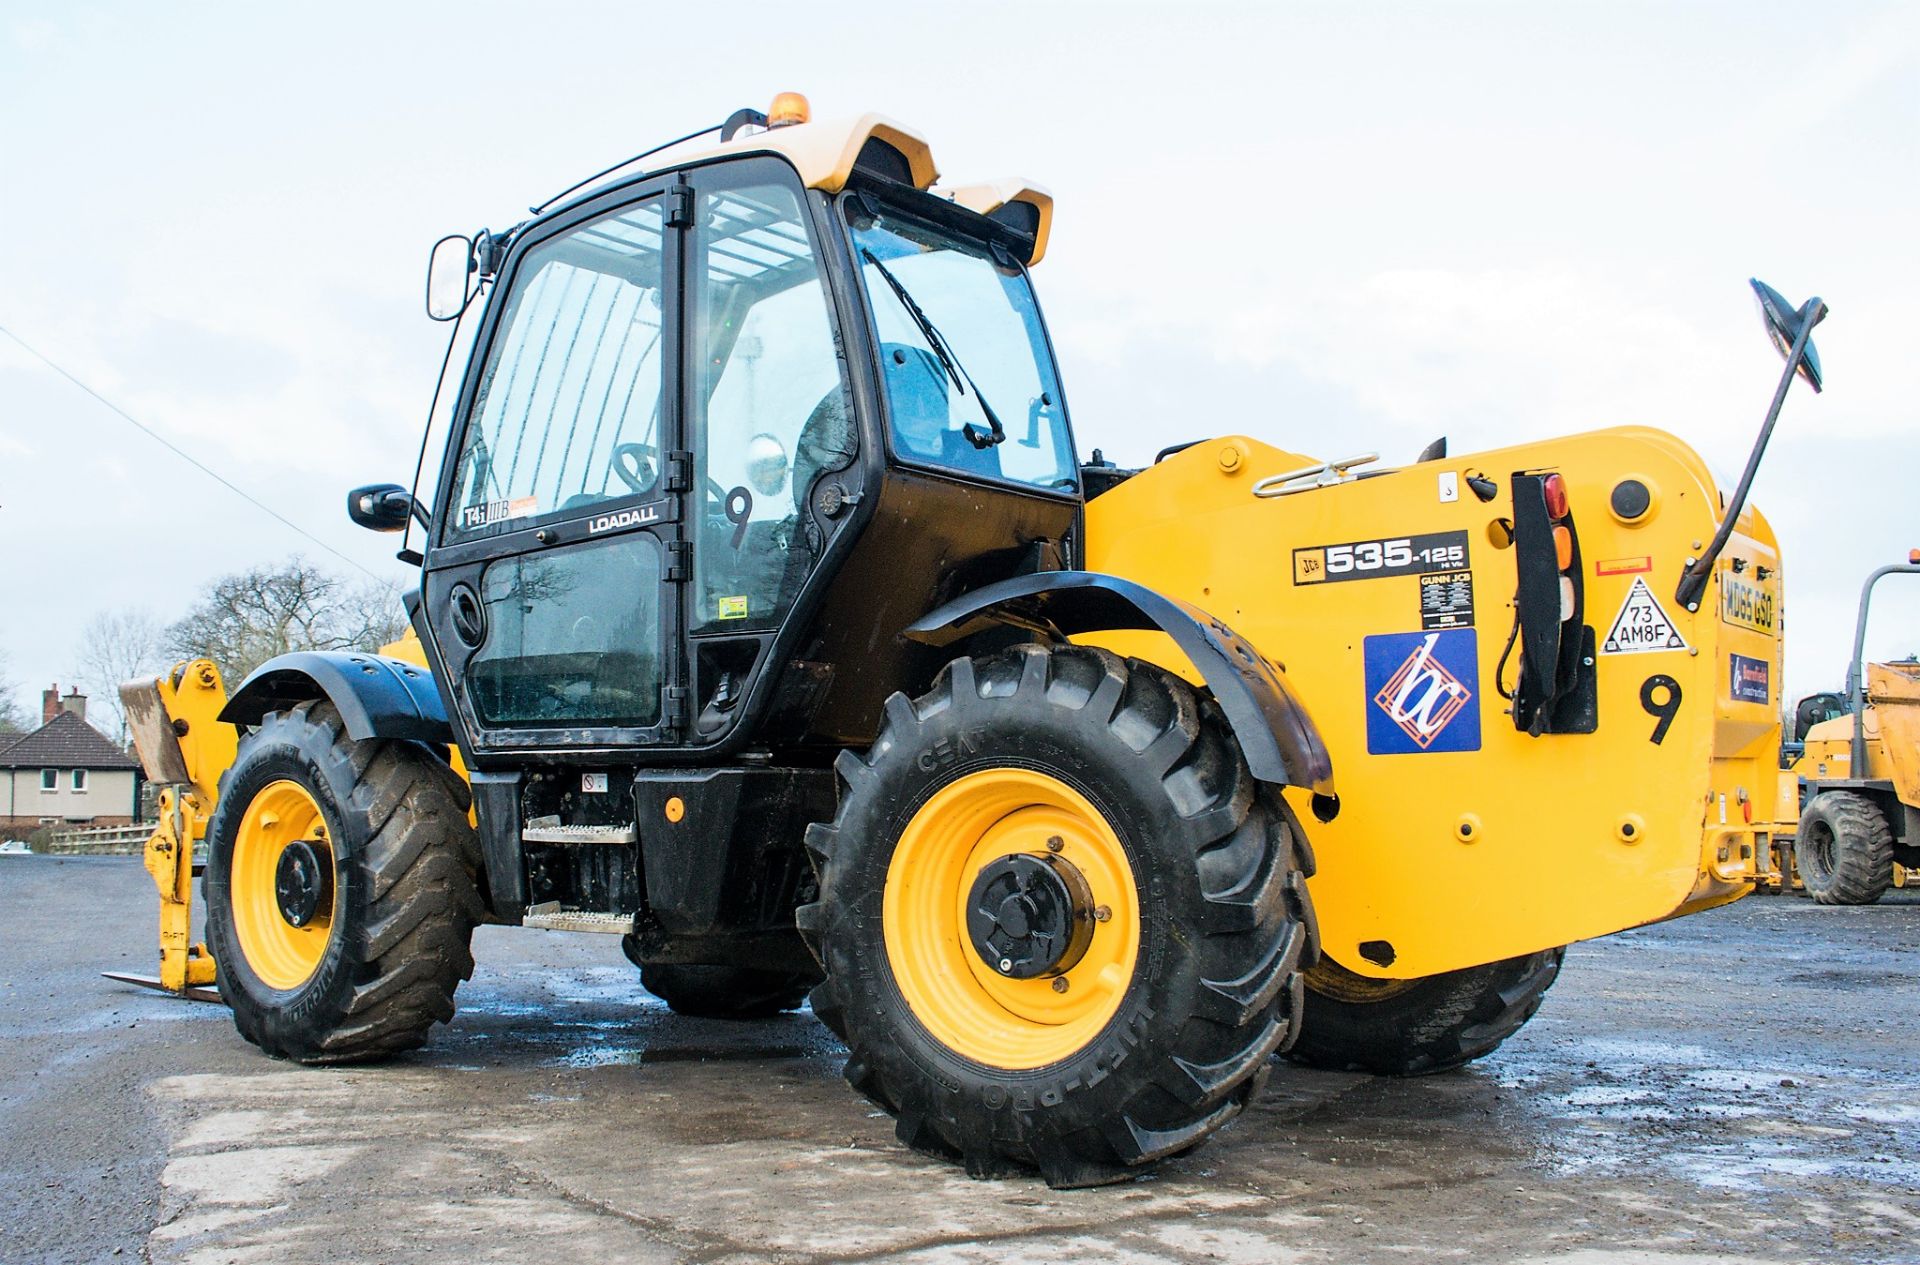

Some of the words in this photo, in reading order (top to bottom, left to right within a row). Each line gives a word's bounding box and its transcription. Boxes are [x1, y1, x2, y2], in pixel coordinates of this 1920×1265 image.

[464, 505, 487, 526] T4i
[589, 507, 658, 534] LOADALL
[725, 485, 753, 550] 9
[1303, 558, 1320, 574] JCB
[1421, 575, 1450, 585] GUNN
[1451, 572, 1471, 582] JCB
[1630, 606, 1652, 623] 73
[1620, 624, 1665, 643] AM8F
[1640, 674, 1682, 745] 9
[917, 725, 986, 772] CEAT
